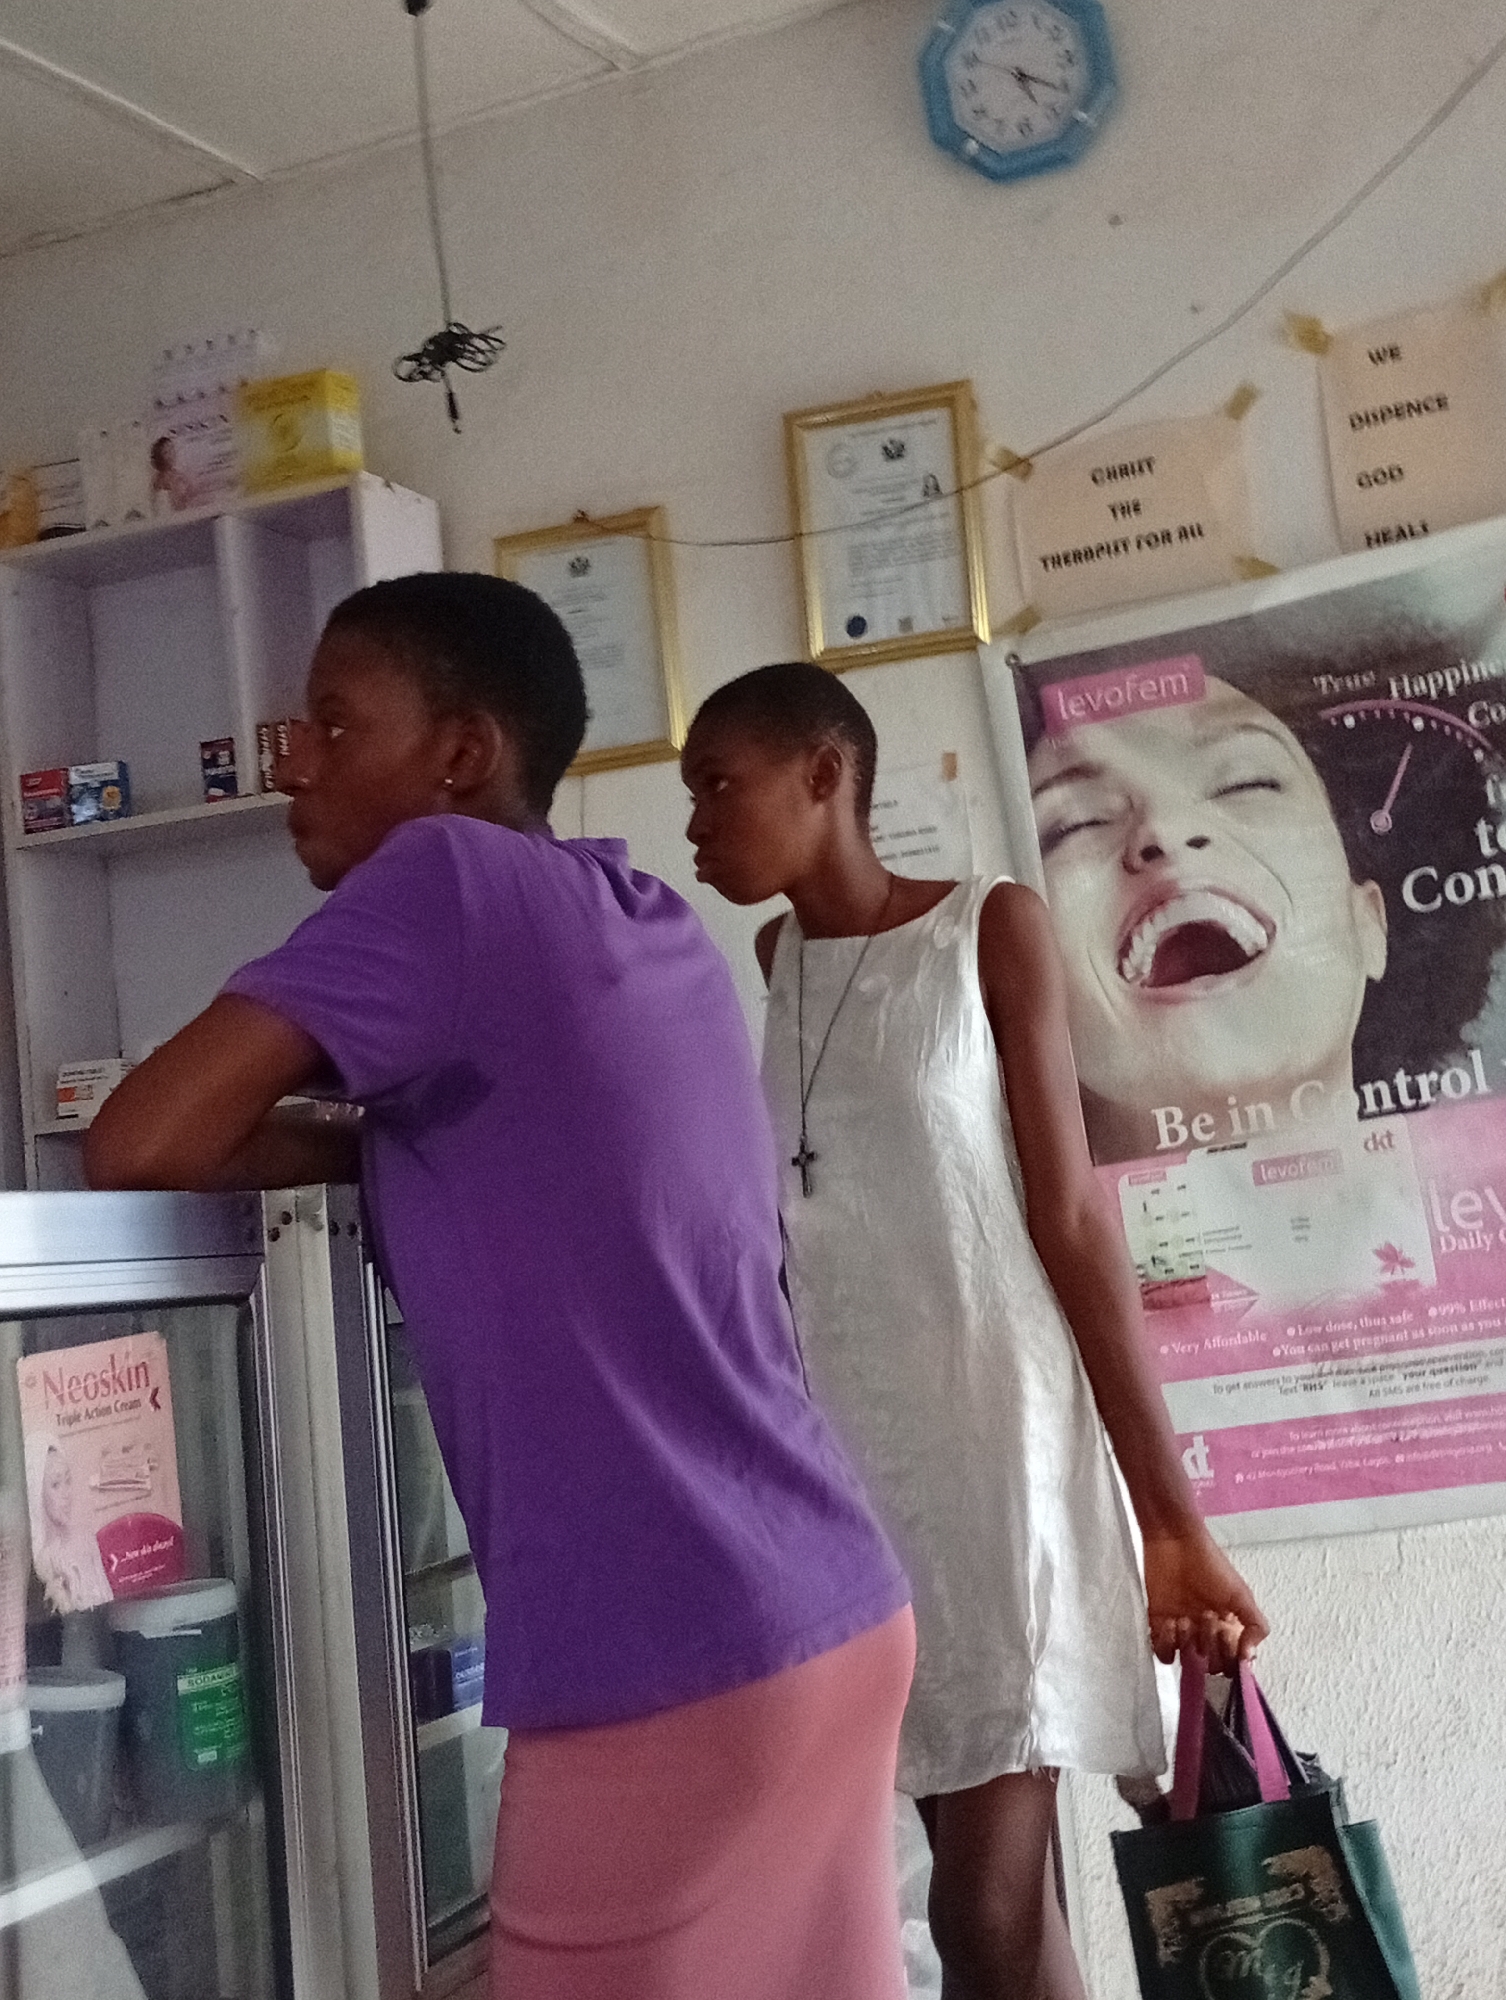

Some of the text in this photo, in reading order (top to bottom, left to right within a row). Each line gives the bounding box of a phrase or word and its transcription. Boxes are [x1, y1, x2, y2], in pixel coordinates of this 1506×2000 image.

[1367, 343, 1402, 366] WE
[1349, 392, 1450, 432] DISPENCE
[1091, 456, 1156, 487] CHRIST
[1356, 464, 1404, 490] GOD
[1107, 499, 1142, 521] THE
[1039, 522, 1204, 573] THERAPIST FOR ALL
[1058, 673, 1189, 720] levofem
[1151, 1049, 1493, 1150] Be in Control
[1364, 1129, 1396, 1153] dkt
[1440, 1230, 1493, 1253] Daily
[1172, 1329, 1267, 1355] Very Affordable
[1280, 1343, 1305, 1355] You
[42, 1351, 150, 1410] Neoskin
[56, 1398, 141, 1427] Triple Action Cream
